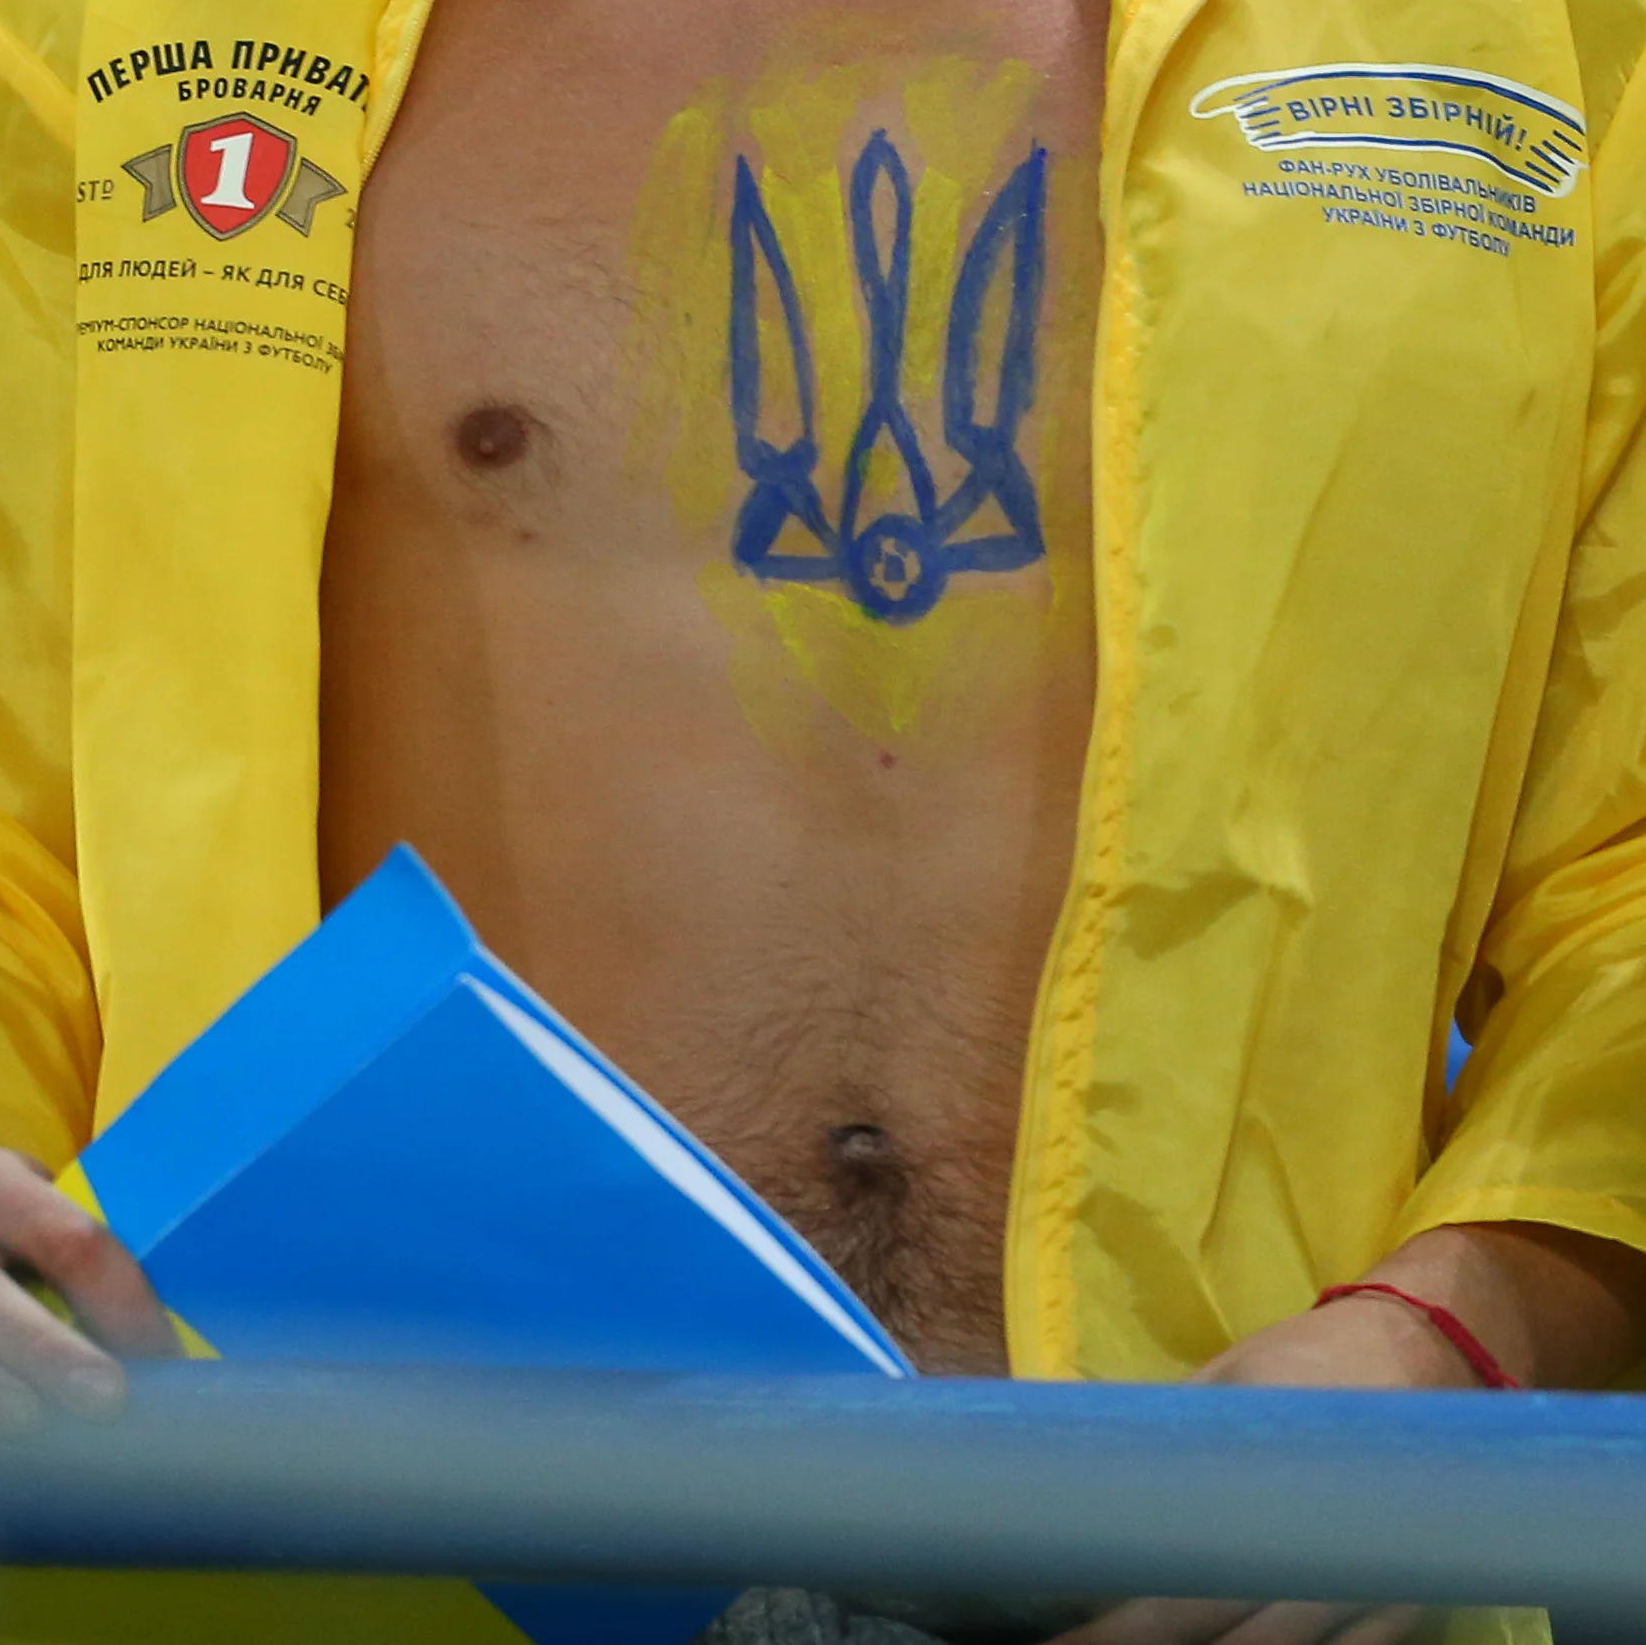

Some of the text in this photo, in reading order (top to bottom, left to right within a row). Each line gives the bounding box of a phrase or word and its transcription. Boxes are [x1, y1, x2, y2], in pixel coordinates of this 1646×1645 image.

[87, 40, 370, 108] ПЕРША ПРИВАТ
[178, 78, 322, 116] БРОВАРНЯ
[1287, 95, 1528, 151] ВІРНІ ЗБІРНІЙ!
[76, 179, 115, 202] STD
[200, 132, 254, 210] 1
[1278, 158, 1538, 215] ФАН-РУХ УБОЛІВАЛЬНИКІВ
[1242, 181, 1577, 248] НАЦІОНАЛЬНОЇ ЗБІРНОЇ КОМАНДИ
[1322, 206, 1409, 233] УКРАЇНИ
[79, 262, 113, 284] ДЛЯ
[118, 258, 196, 281] ЛЮДЕЙ
[221, 264, 253, 282] ЯК
[255, 268, 305, 291] ДЛЯ
[76, 317, 189, 336] ЕМІУМ-СПОНСОР
[195, 319, 324, 350] НАЦІОНАЛЬНОЇ
[97, 336, 164, 353] КОМАНДИ
[169, 335, 239, 354] УКРАЇНИ
[258, 343, 333, 375] ФУТБОЛУ
